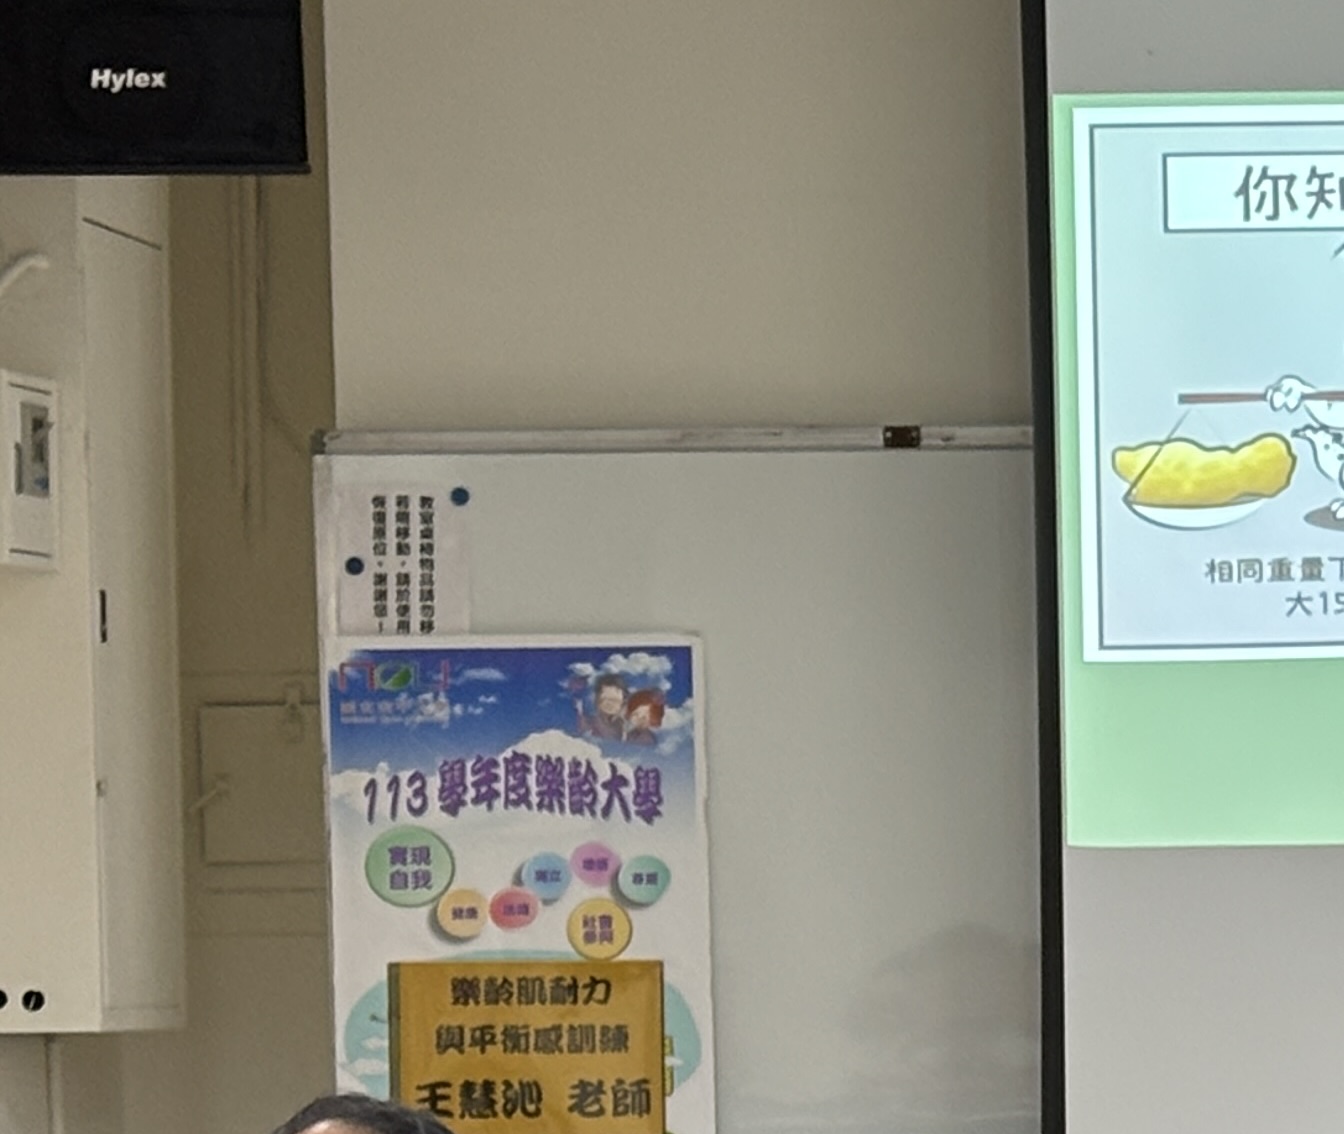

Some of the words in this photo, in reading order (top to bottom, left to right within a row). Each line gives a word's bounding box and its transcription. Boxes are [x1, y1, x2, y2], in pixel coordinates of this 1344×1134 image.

[91, 68, 167, 94] Hylex
[363, 770, 429, 824] 113
[437, 750, 664, 827] 學年度樂齡大學
[388, 870, 433, 892] 自我
[451, 975, 613, 1007] 樂齡肌耐力
[435, 1023, 631, 1056] 與平衡感訓練
[415, 1078, 544, 1120] 王慧沁
[567, 1078, 653, 1119] 老師
